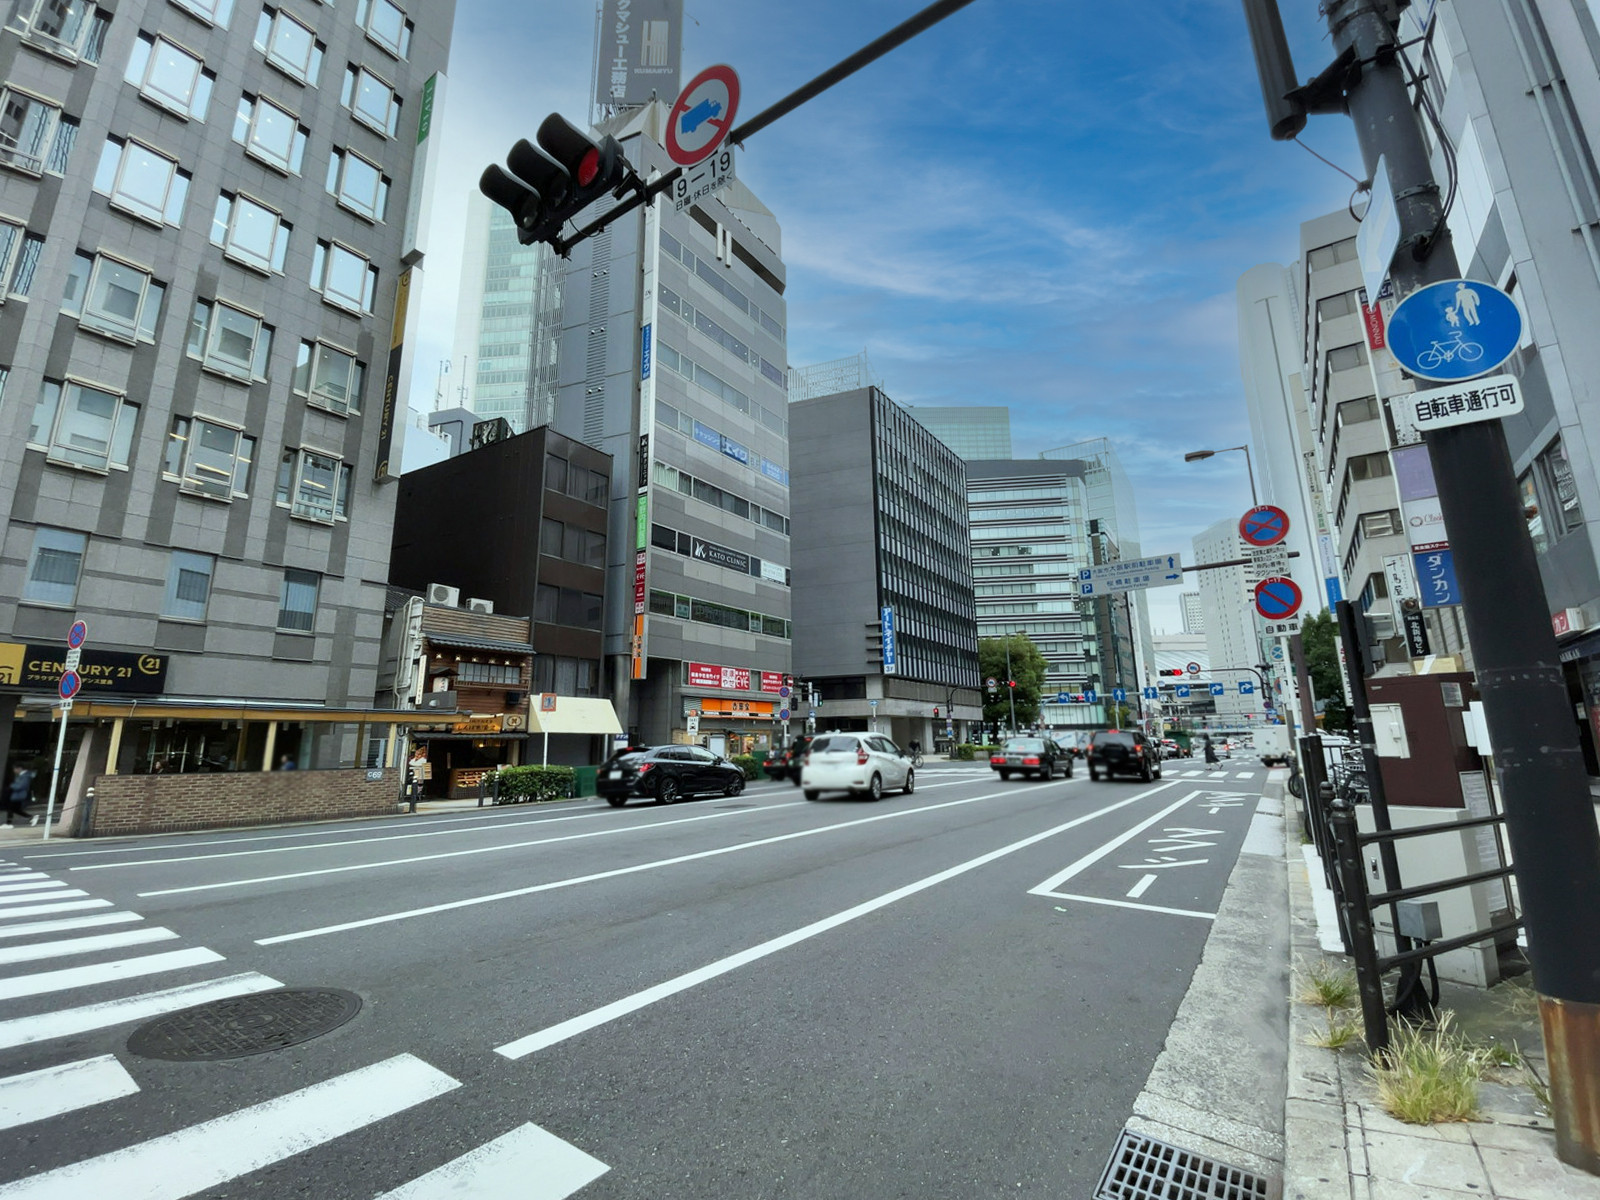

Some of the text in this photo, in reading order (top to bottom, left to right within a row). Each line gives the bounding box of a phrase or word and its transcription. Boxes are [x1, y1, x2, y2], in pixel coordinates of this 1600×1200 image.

[1415, 383, 1517, 422] 自転車通行可
[709, 550, 726, 561] KATO
[726, 556, 747, 568] CLINIC
[1427, 553, 1450, 605] ダンカン
[1265, 622, 1298, 634] 自動車
[28, 660, 132, 678] CENURY 21
